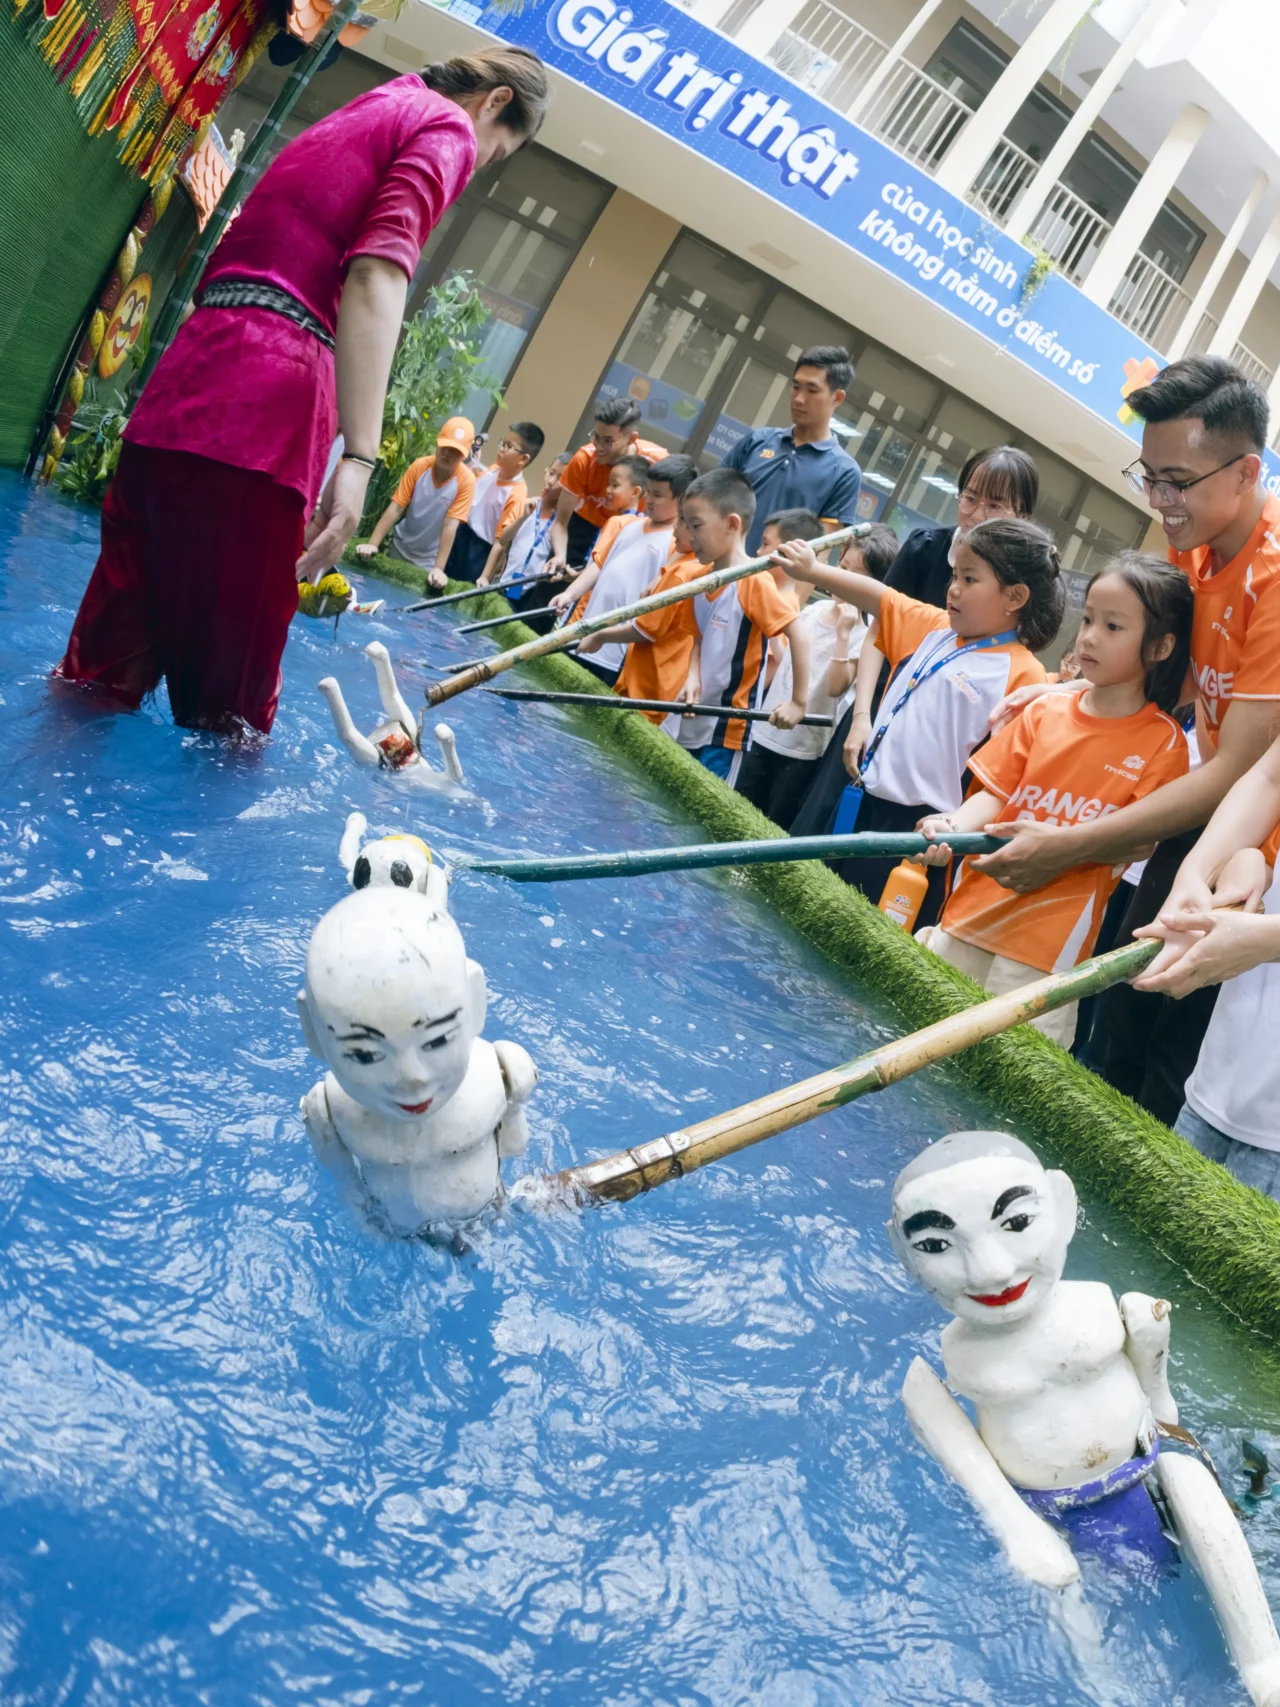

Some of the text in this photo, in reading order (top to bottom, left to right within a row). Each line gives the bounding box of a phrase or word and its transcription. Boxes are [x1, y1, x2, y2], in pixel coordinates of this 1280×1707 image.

[556, 0, 860, 197] Giá trị thật
[858, 208, 1101, 385] không nằm ở điểm số
[881, 183, 1018, 290] của học sinh
